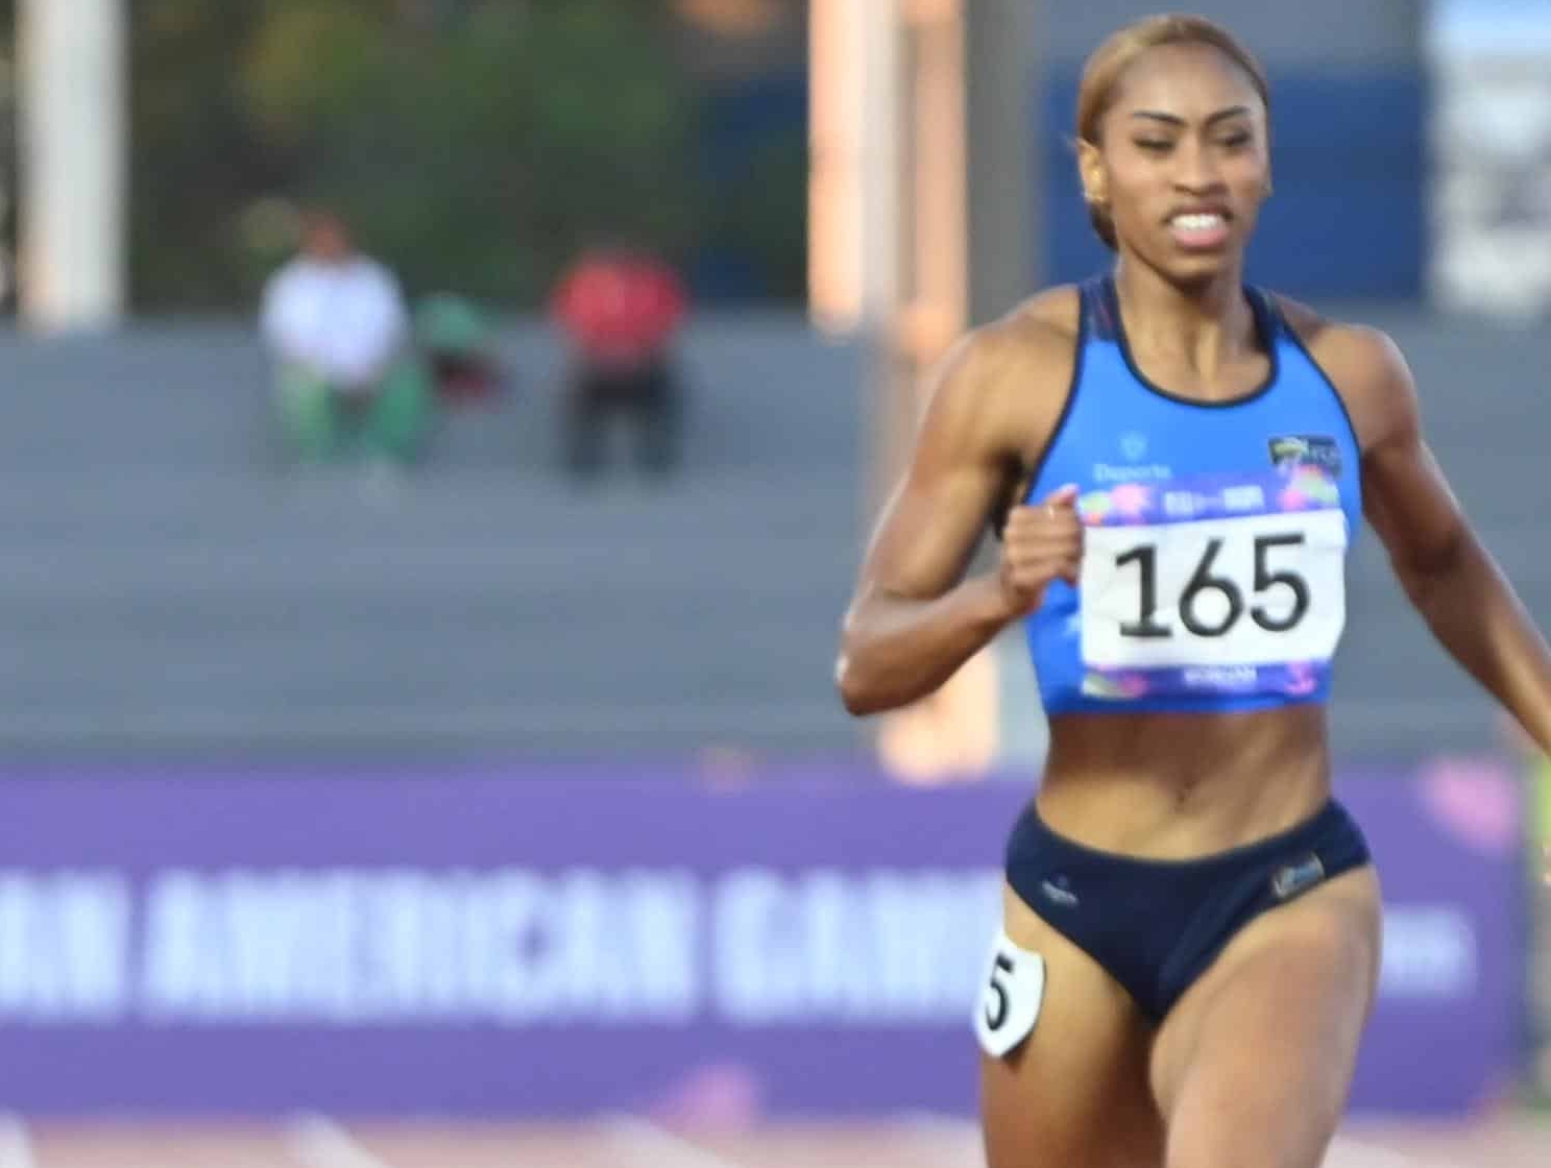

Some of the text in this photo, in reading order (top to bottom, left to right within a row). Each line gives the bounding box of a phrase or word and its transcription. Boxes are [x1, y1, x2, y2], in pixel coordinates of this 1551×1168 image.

[1114, 531, 1311, 639] 165
[147, 866, 693, 1022] AMERICAN
[985, 952, 1016, 1032] 5
